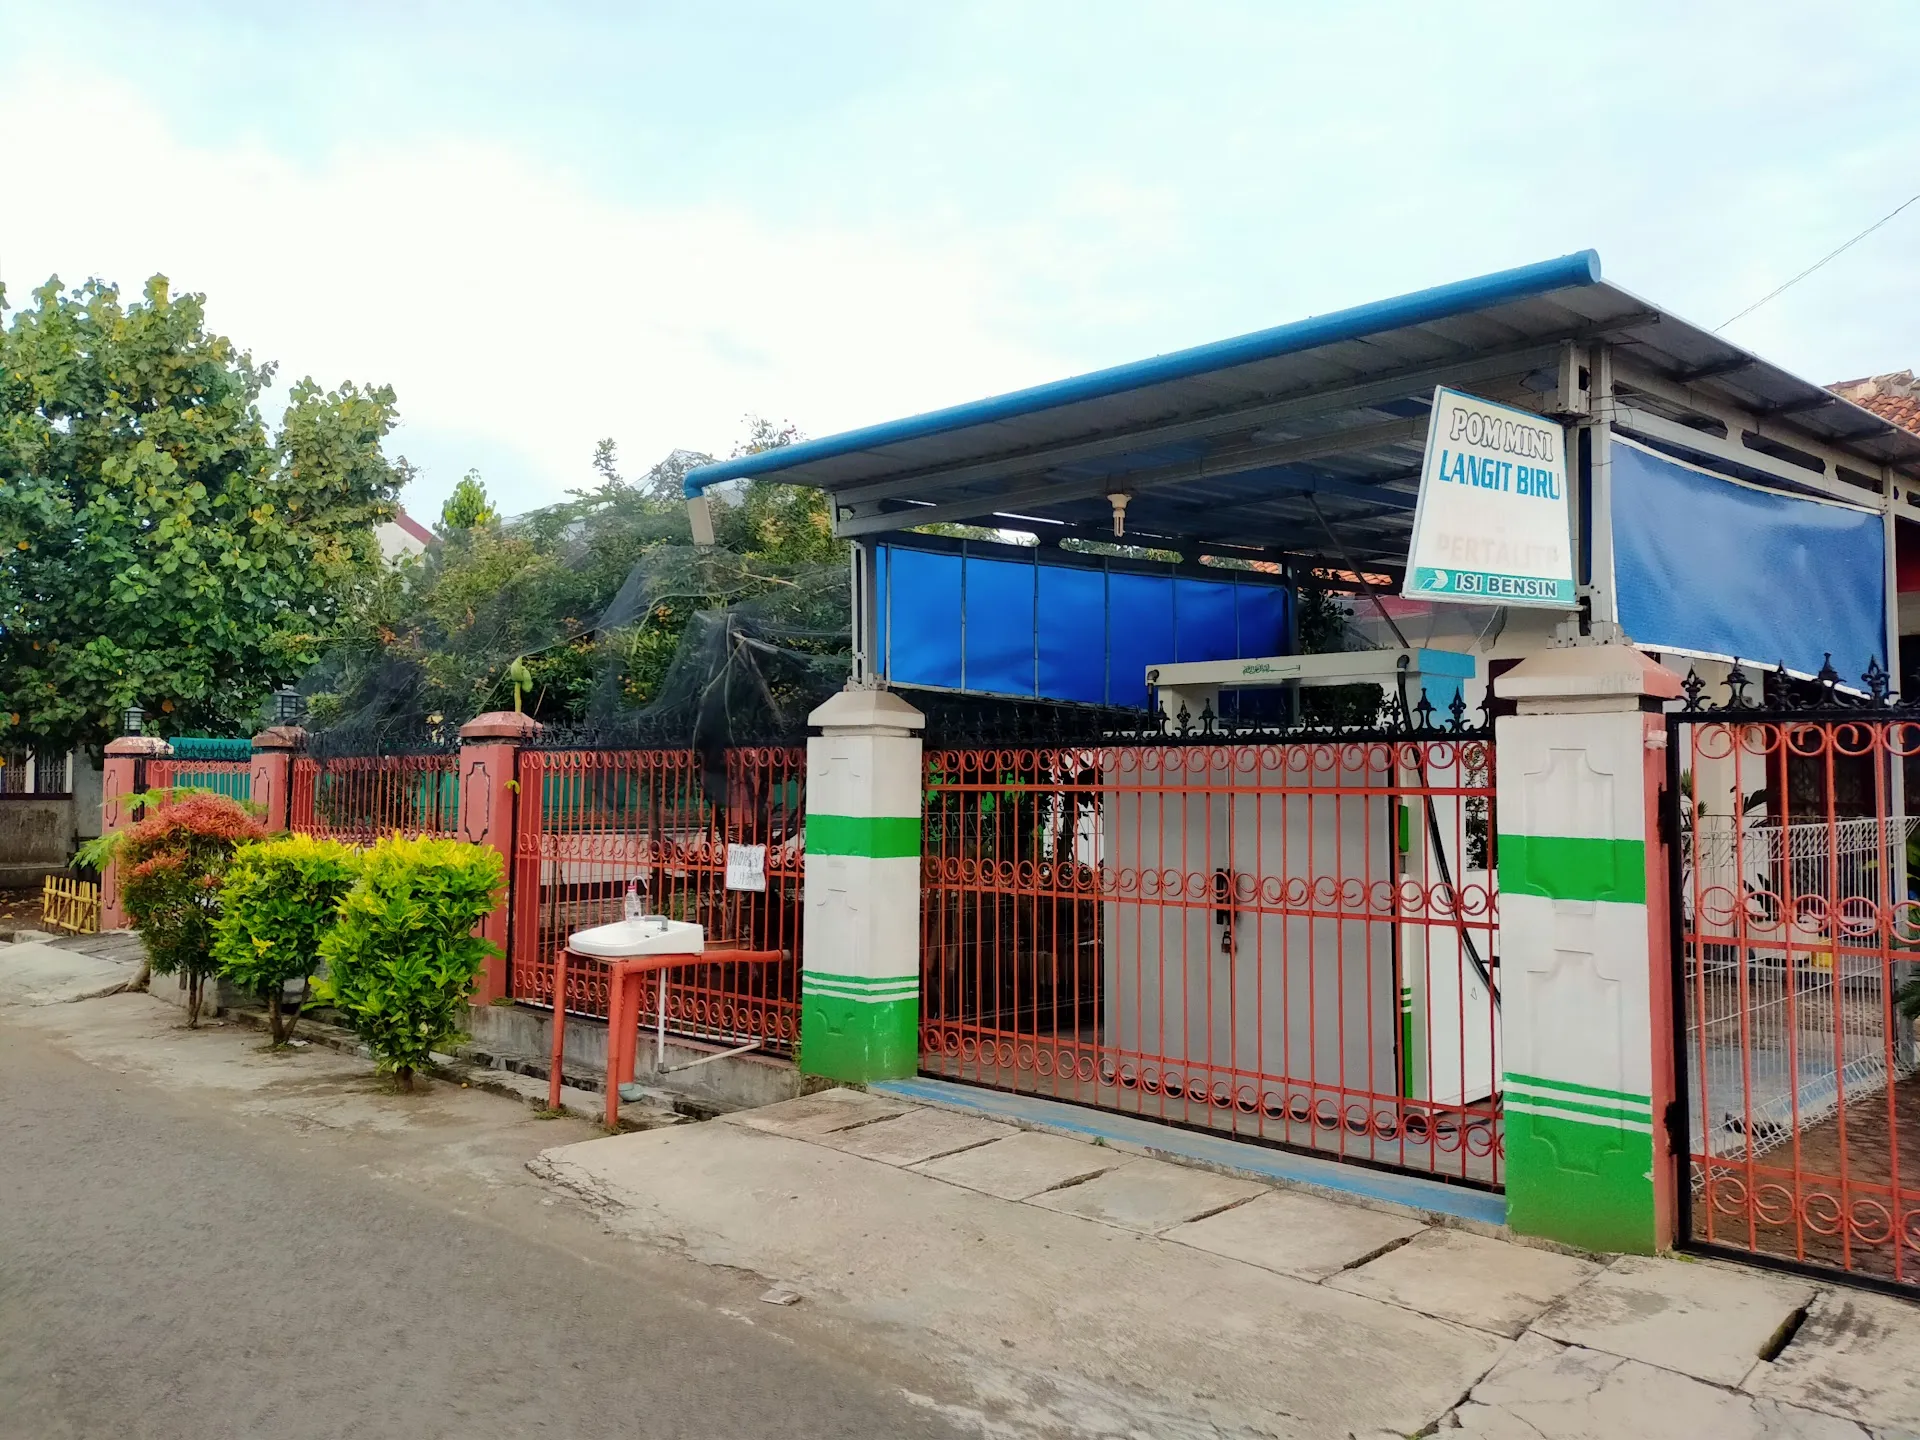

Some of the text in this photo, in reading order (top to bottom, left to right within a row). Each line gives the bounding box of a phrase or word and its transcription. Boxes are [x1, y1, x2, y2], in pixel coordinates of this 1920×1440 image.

[1450, 408, 1553, 462] POM MINI
[1439, 449, 1560, 500] LANGIT BIRU
[1456, 573, 1558, 598] ISI BENSIN
